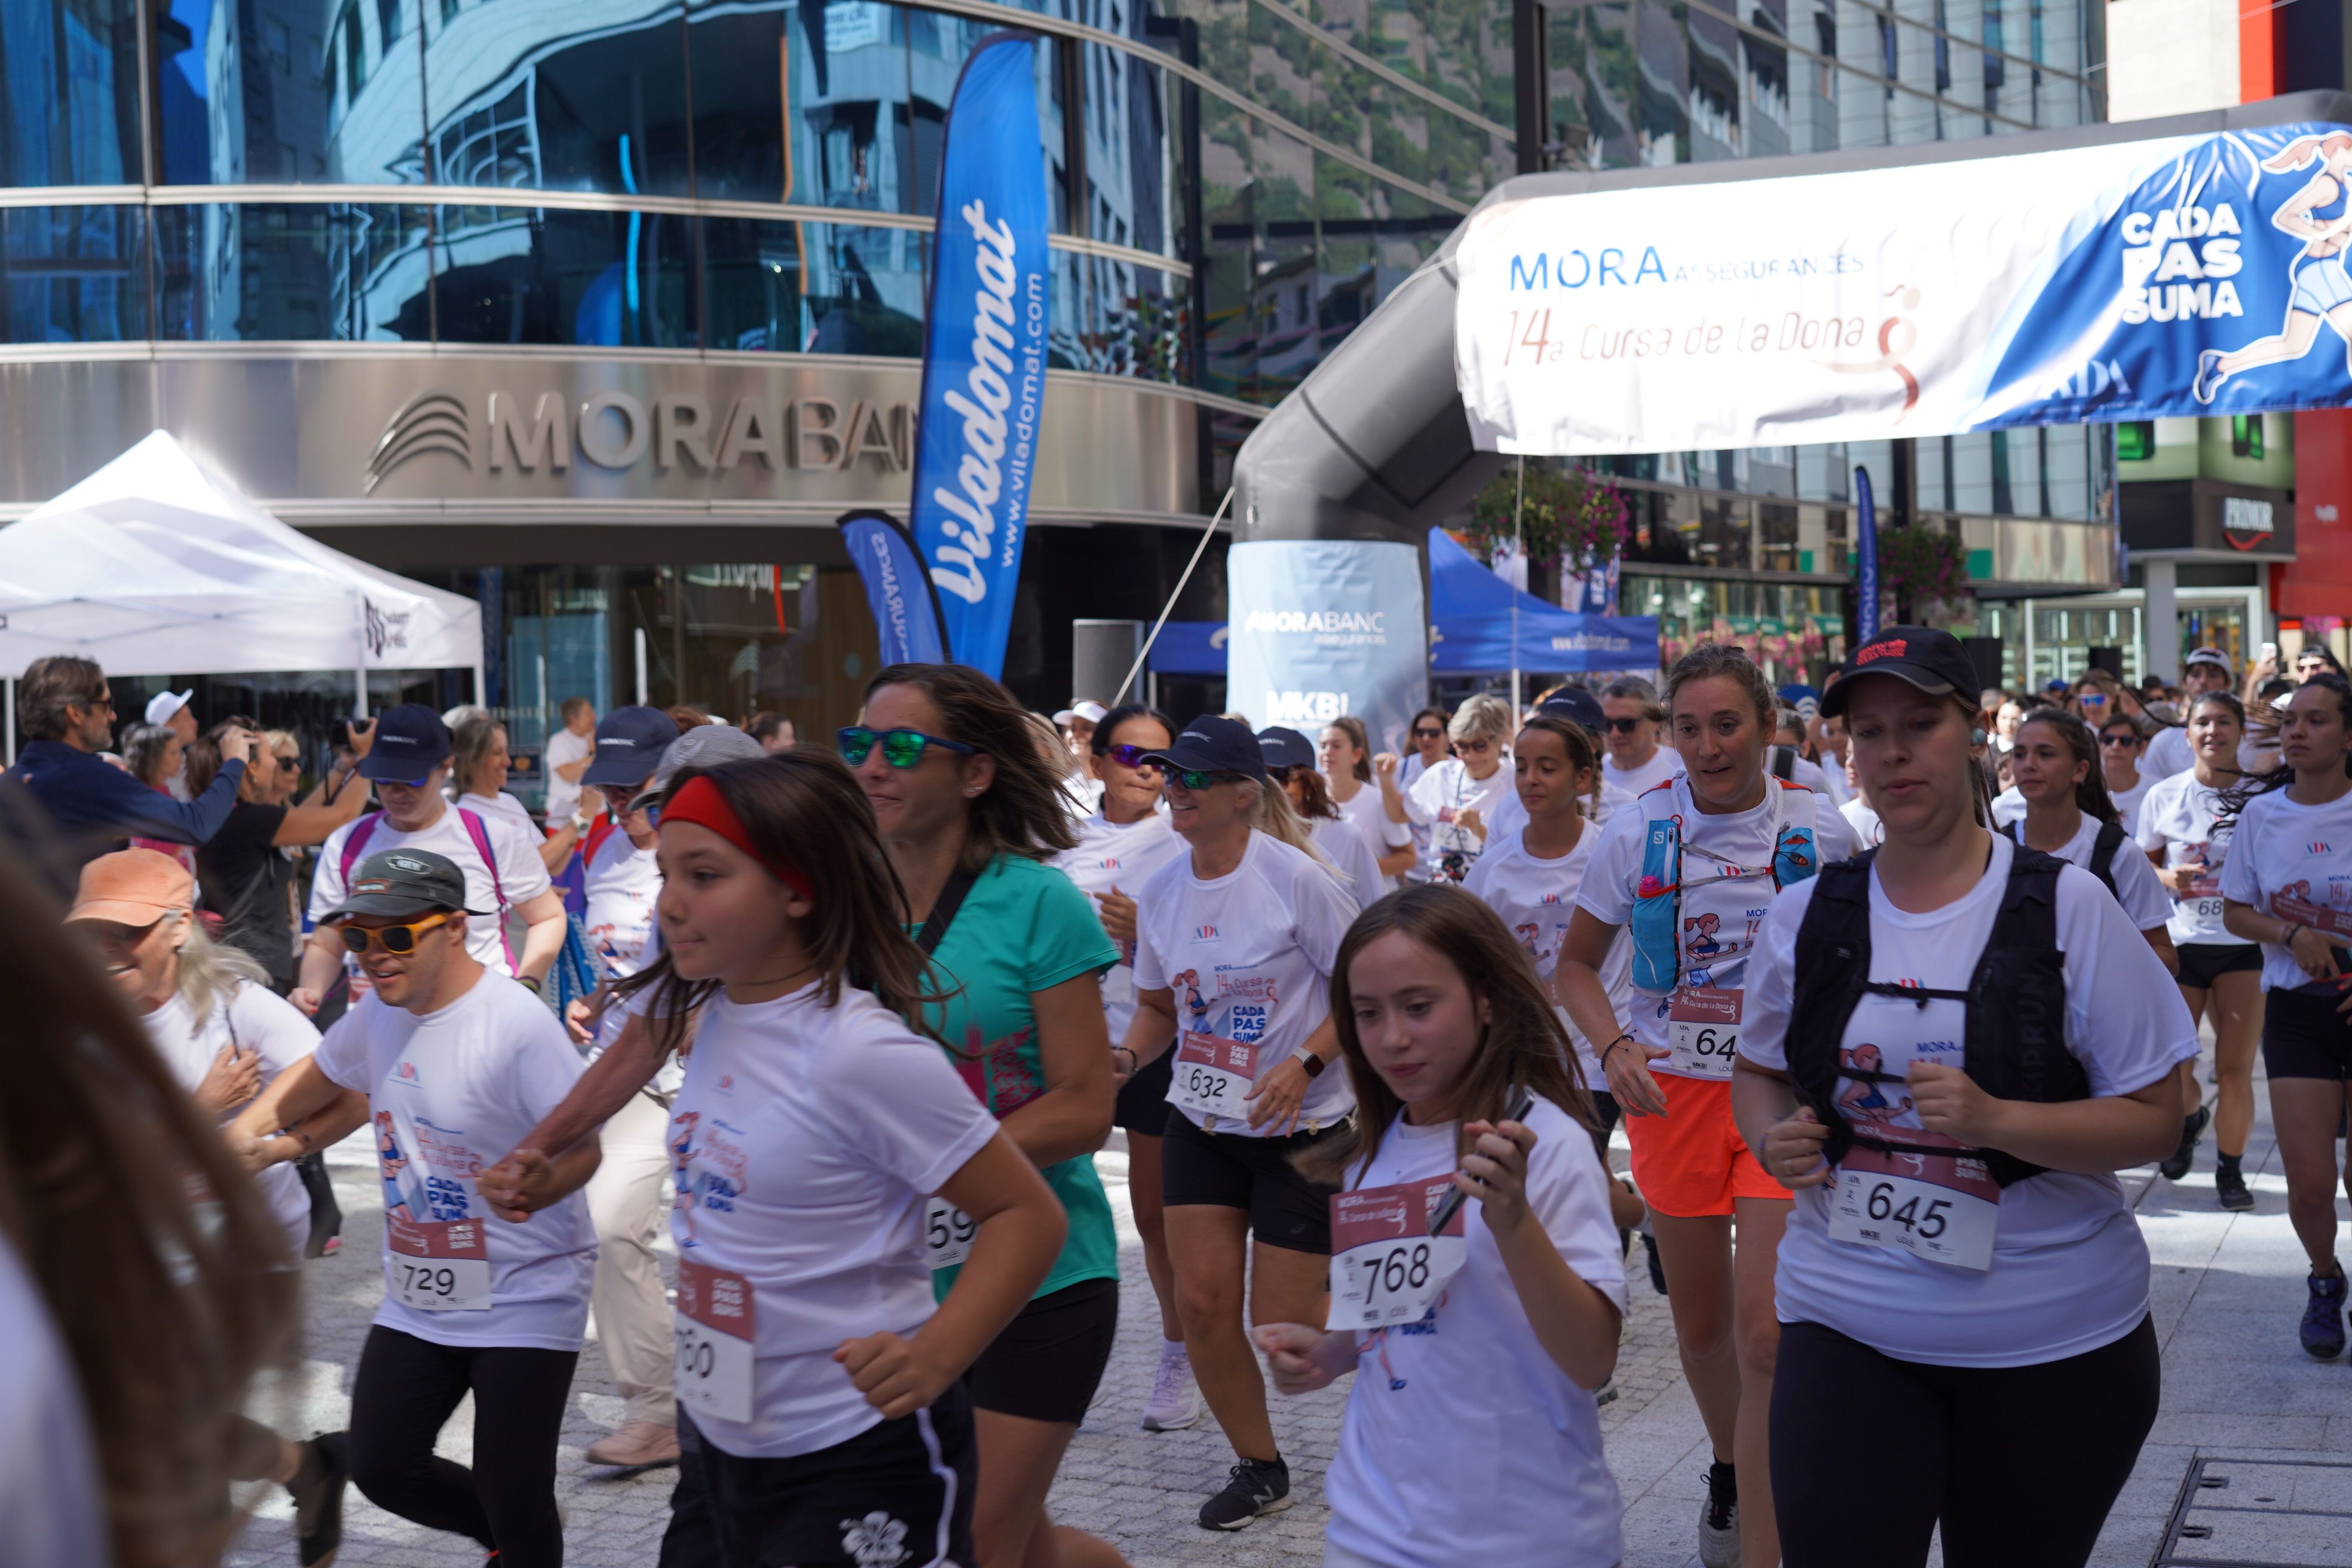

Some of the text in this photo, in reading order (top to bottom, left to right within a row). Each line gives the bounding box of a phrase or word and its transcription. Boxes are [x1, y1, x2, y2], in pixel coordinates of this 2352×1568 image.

[2122, 203, 2242, 244] CADA
[1510, 246, 1668, 291] MORA
[2123, 238, 2243, 287] PAS
[2123, 280, 2243, 324] SUMA
[1581, 323, 1673, 360] Cursa
[1685, 318, 1723, 355] de
[1778, 311, 1864, 351] Dona
[1002, 272, 1043, 568] www.viladomat.com
[1265, 691, 1349, 721] MKB!
[2198, 899, 2222, 916] 68
[1233, 1006, 1266, 1016] CADA
[1233, 1017, 1267, 1031] PAS
[1696, 1028, 1737, 1062] 64
[1190, 1068, 1227, 1098] 632
[1867, 1182, 1953, 1239] 645
[402, 1264, 455, 1296] 729
[1363, 1243, 1431, 1304] 768
